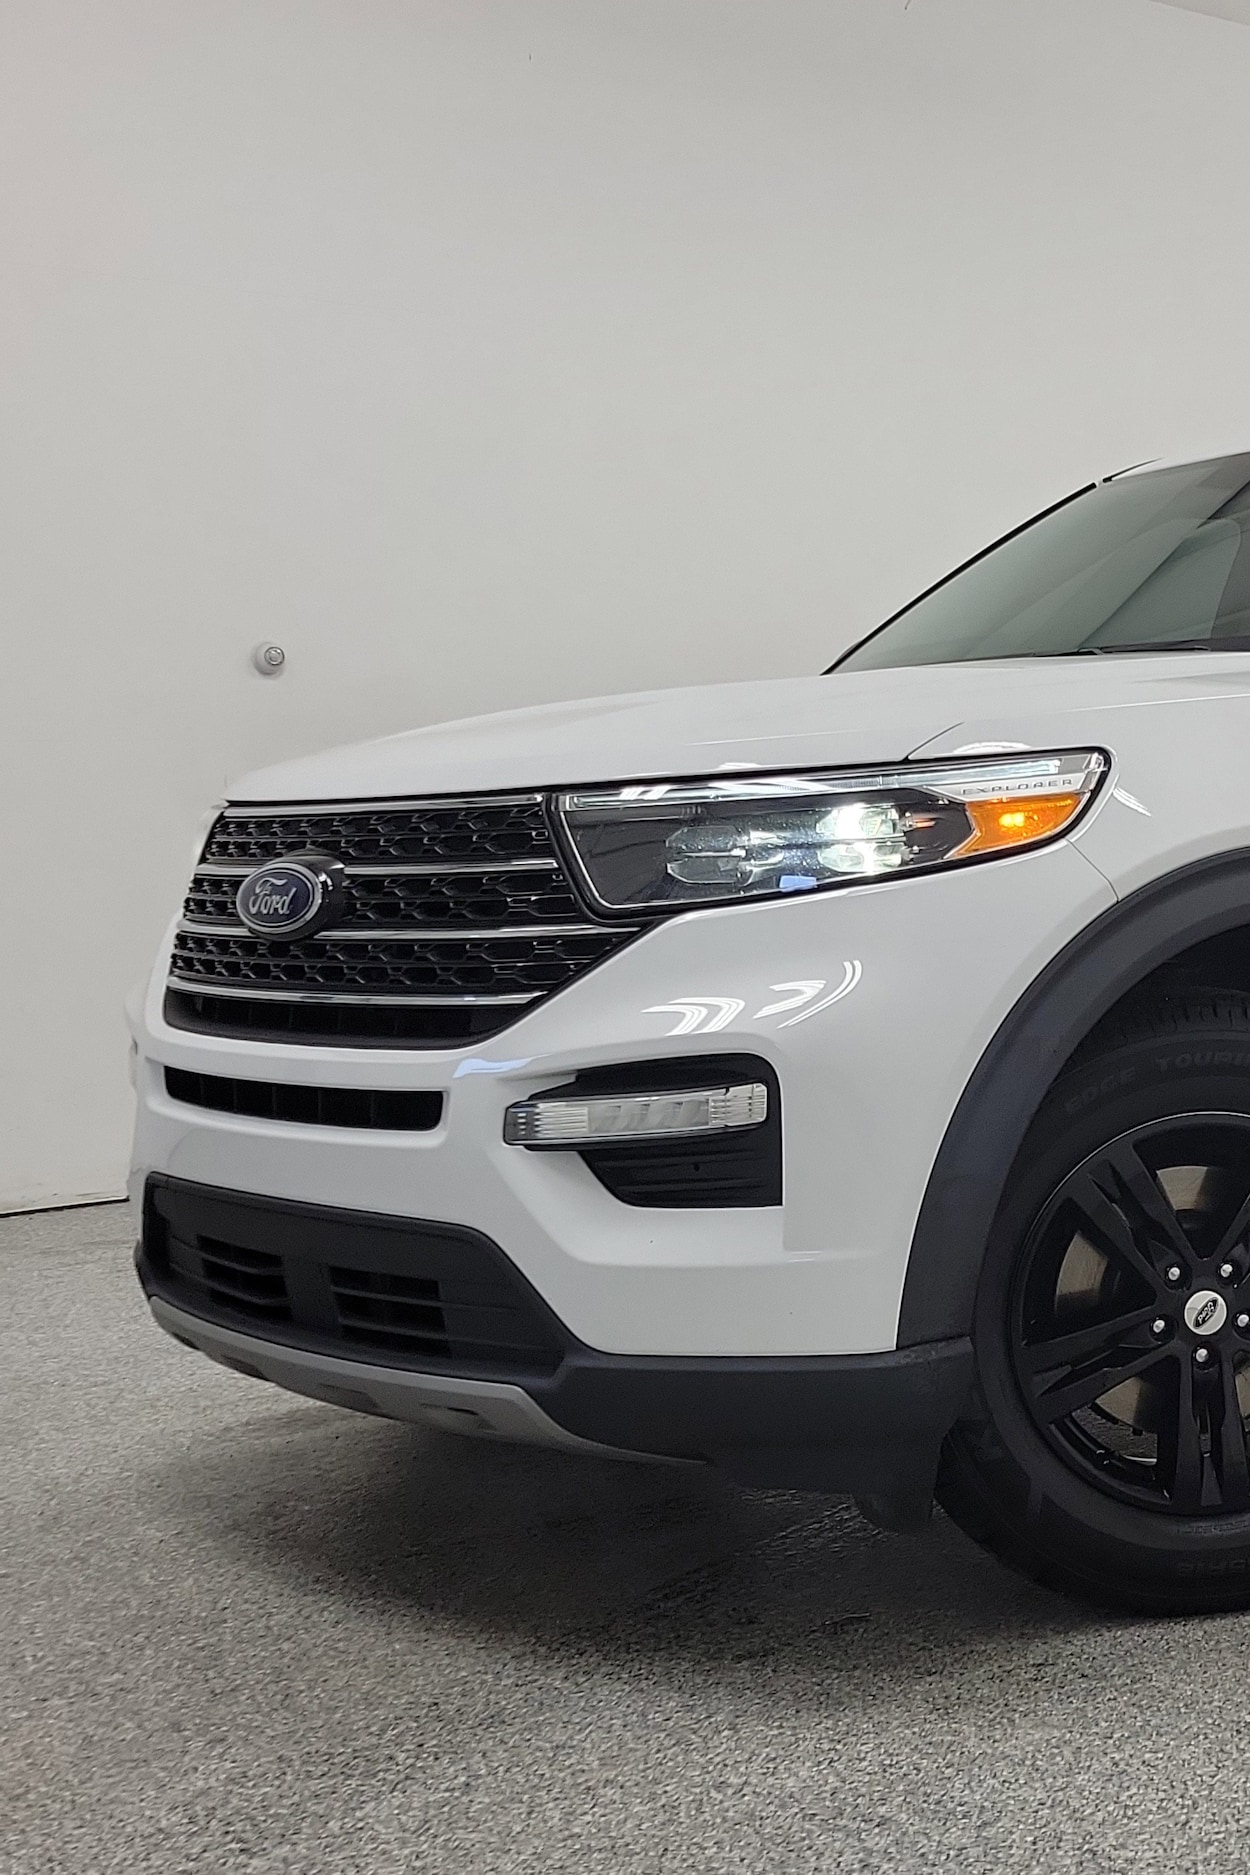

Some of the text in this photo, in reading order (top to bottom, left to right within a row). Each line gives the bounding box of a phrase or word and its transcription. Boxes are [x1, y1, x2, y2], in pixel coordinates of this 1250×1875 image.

[962, 778, 1072, 796] EXPLORER
[248, 877, 297, 915] Ford
[1063, 1066, 1138, 1114] EDGE
